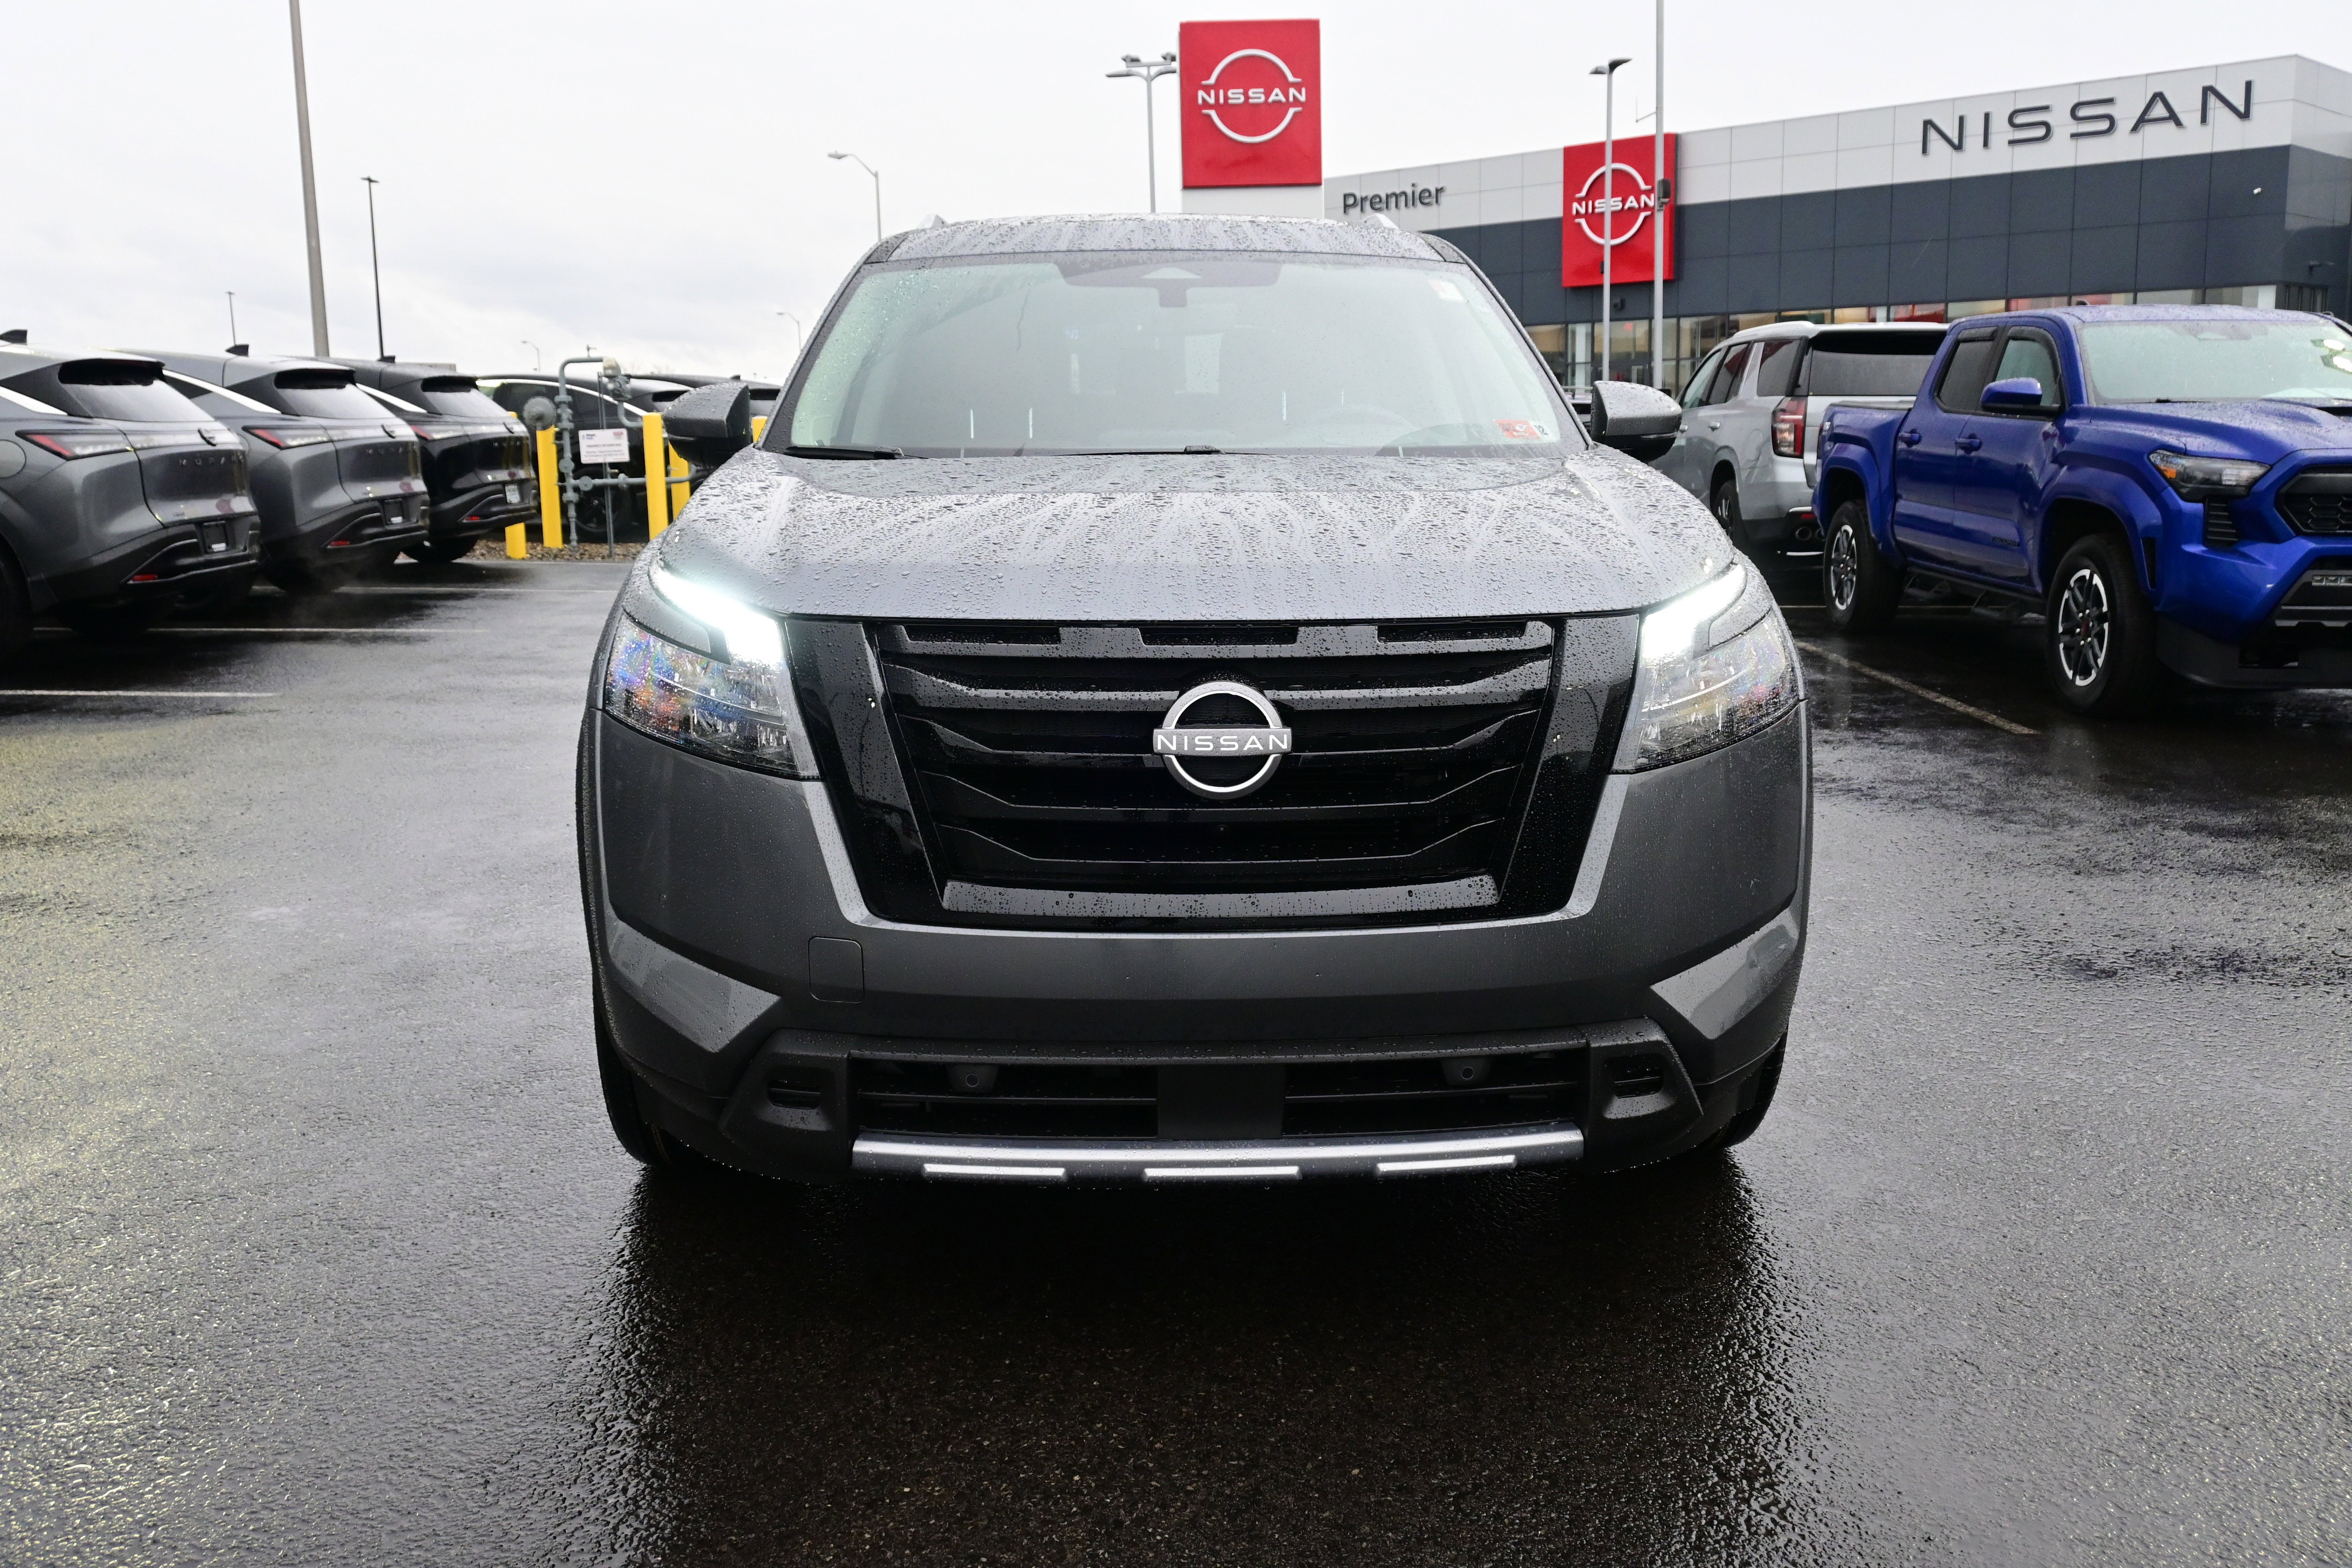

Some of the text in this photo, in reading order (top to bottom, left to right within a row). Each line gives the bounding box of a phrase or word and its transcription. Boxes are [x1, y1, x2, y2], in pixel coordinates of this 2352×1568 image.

[1198, 87, 1306, 105] NISSAN
[1921, 79, 2254, 155] NISSAN
[1343, 182, 1446, 214] Premier
[1572, 193, 1654, 215] NISSAN
[1534, 425, 1548, 435] 12
[1157, 733, 1288, 751] NISSAN
